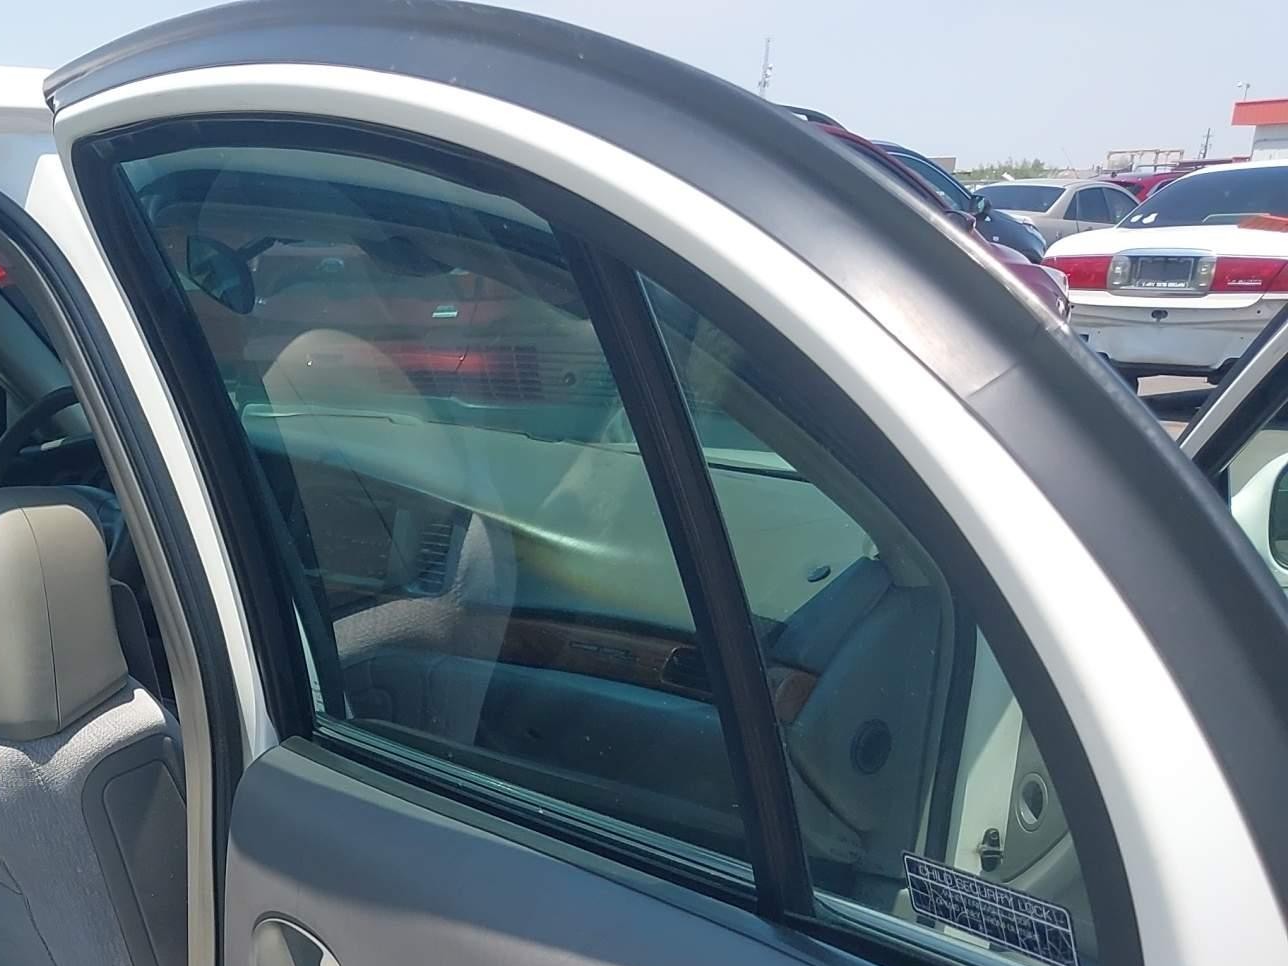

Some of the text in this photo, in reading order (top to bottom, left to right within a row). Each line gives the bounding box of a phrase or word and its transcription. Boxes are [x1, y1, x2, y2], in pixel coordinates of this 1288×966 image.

[918, 864, 953, 887] CHILD
[956, 877, 1013, 906] SECURITY
[1018, 899, 1052, 921] LOCK
